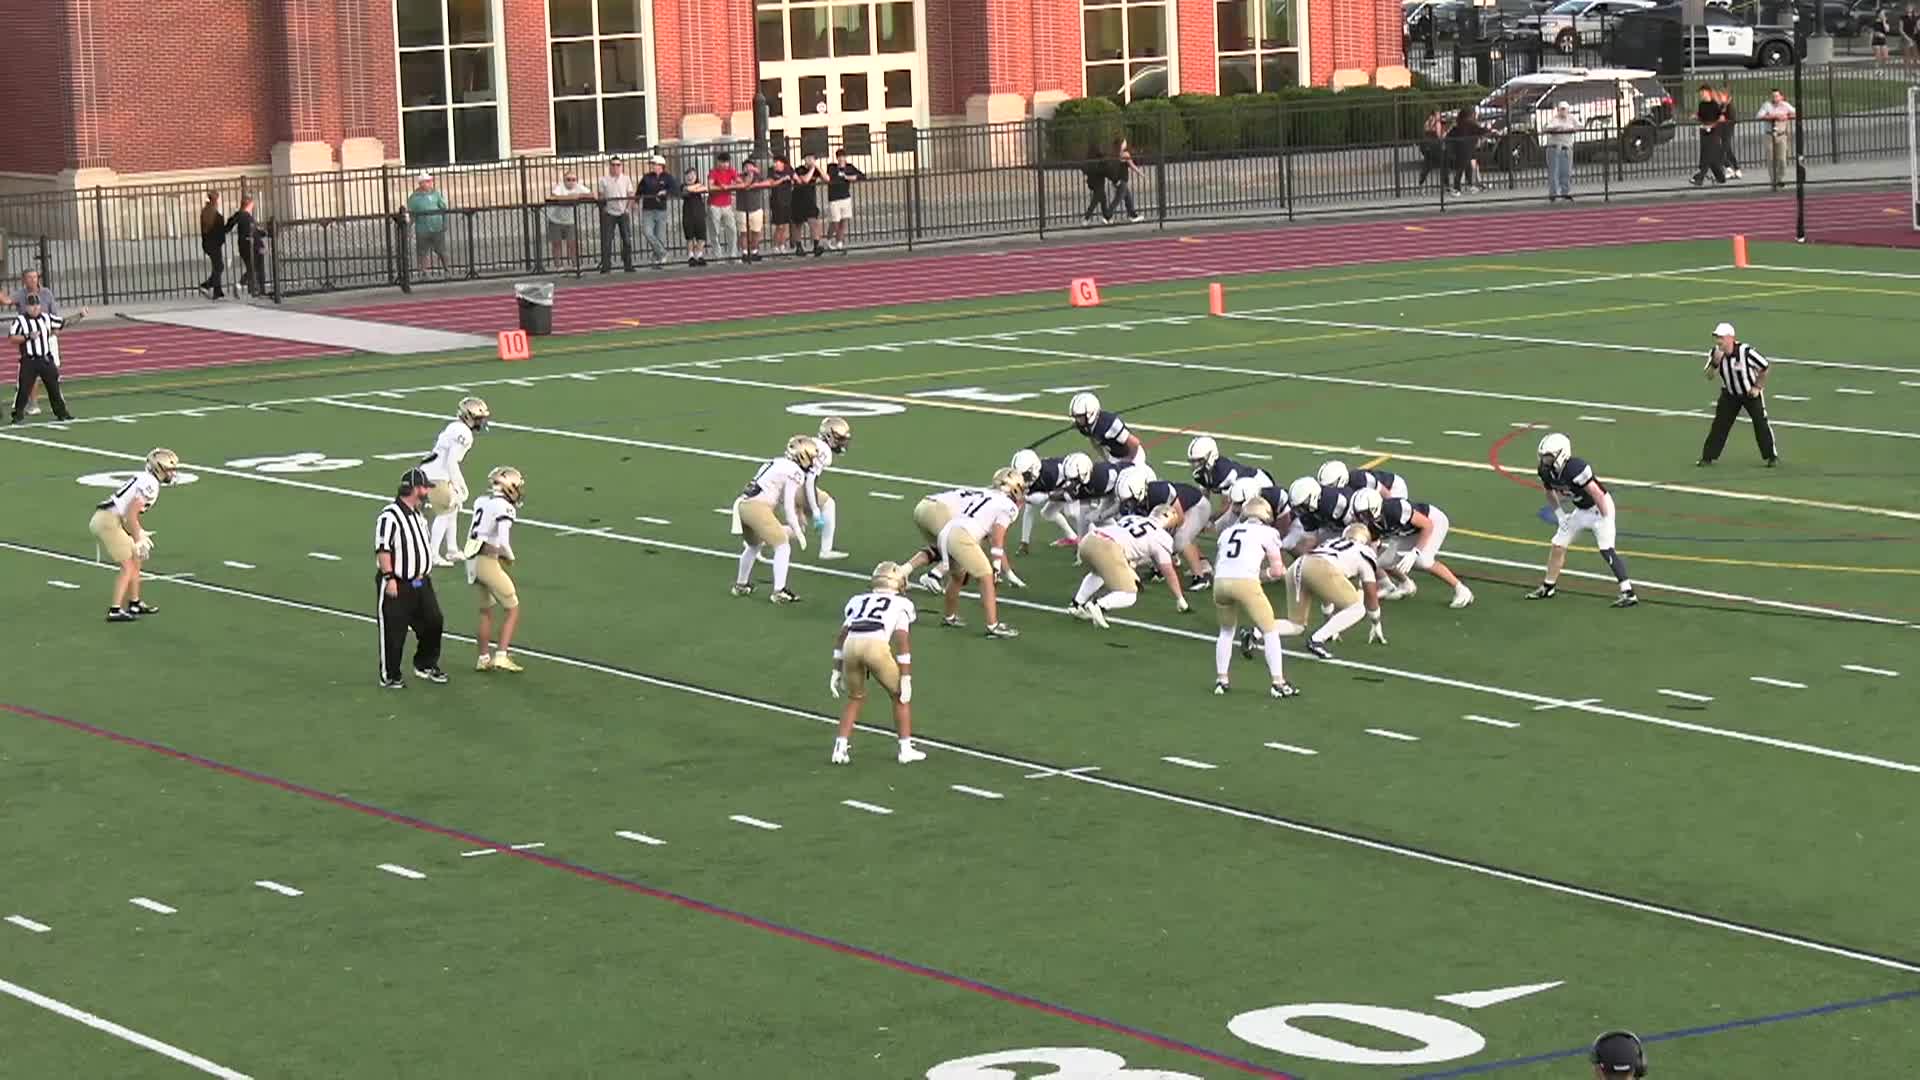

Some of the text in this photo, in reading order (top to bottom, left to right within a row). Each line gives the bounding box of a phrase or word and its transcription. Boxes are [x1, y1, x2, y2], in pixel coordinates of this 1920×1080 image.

[1079, 281, 1092, 301] G
[504, 333, 524, 355] 10
[1226, 529, 1248, 559] 5
[856, 596, 891, 620] 12
